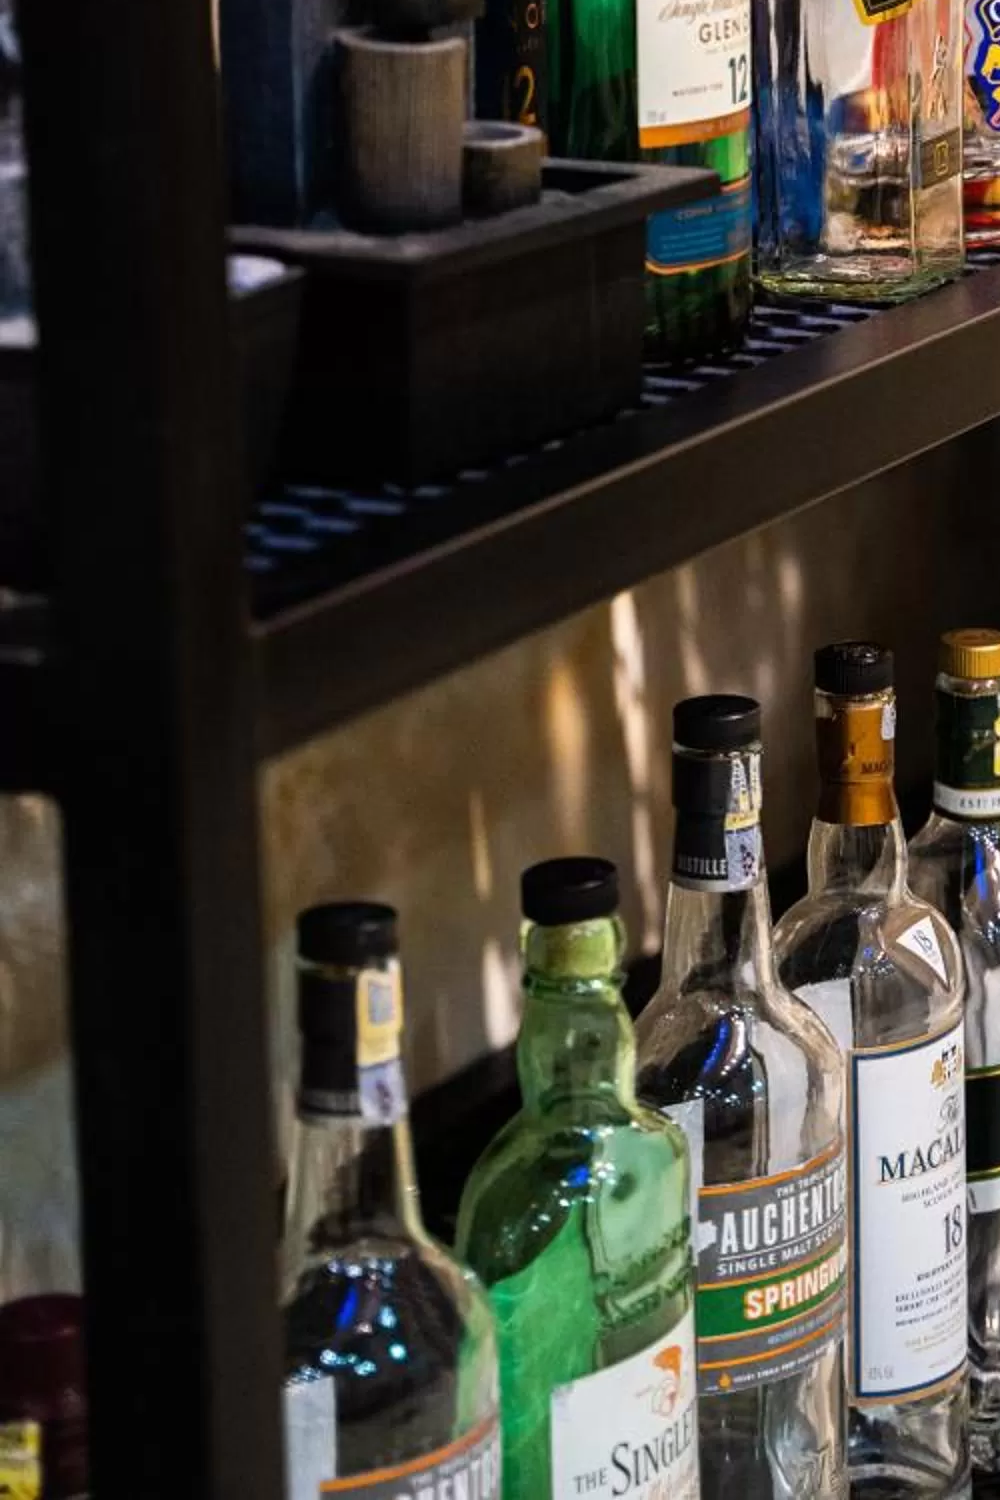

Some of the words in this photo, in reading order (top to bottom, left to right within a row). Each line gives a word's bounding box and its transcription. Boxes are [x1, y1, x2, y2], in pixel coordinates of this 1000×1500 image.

[729, 53, 748, 105] 12
[943, 1203, 963, 1255] 18
[716, 1253, 777, 1277] SINGLE
[780, 1239, 812, 1261] MALT
[574, 1467, 608, 1495] THE
